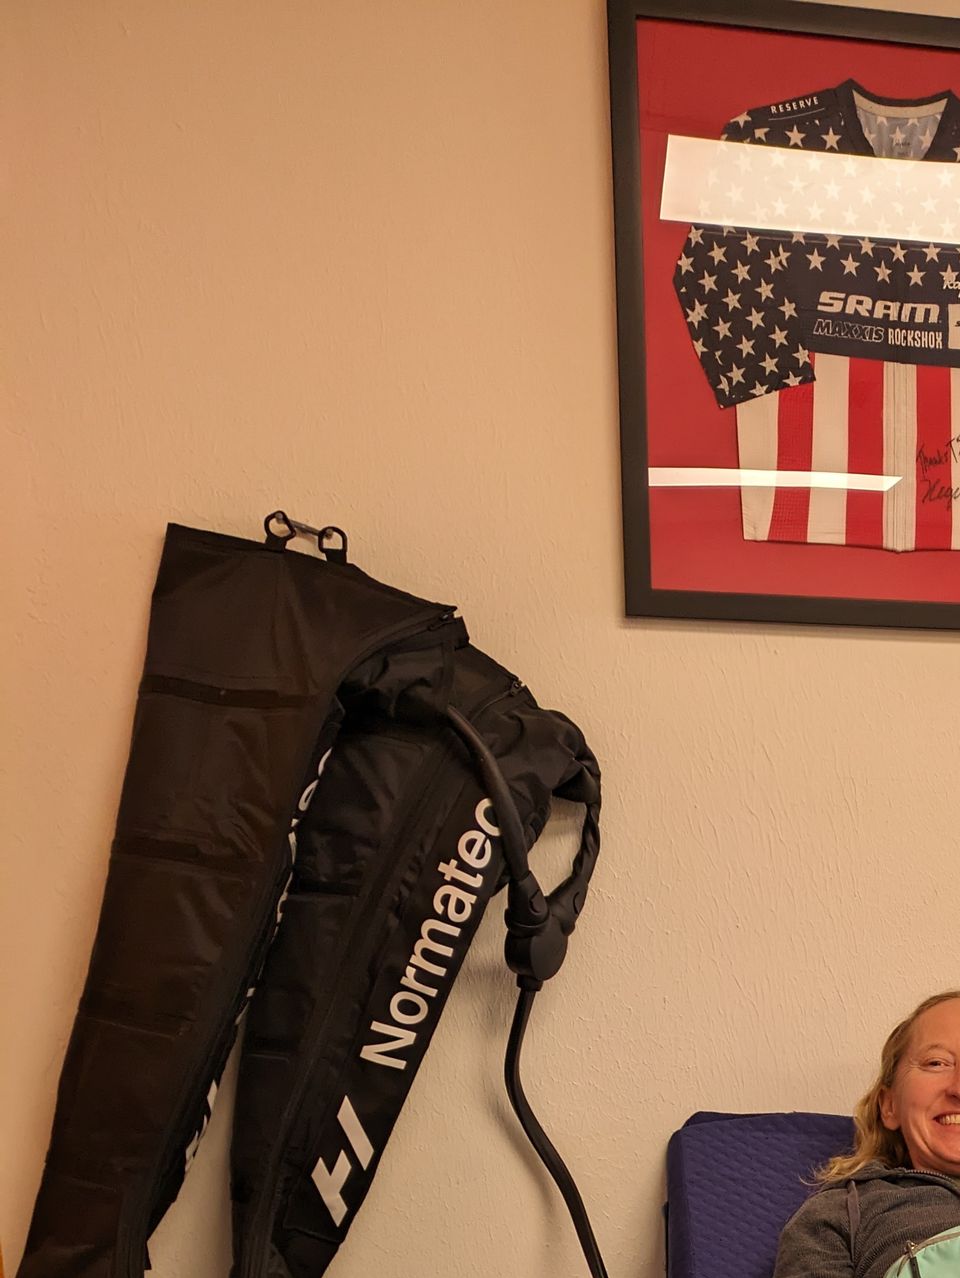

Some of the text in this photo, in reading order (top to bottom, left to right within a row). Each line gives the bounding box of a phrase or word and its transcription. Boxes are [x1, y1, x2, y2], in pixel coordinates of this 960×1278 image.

[770, 96, 819, 115] RESERVE
[817, 291, 940, 324] SRAM
[813, 319, 943, 350] MAXXIS ROCKSHOX
[360, 797, 502, 1070] Normatec
